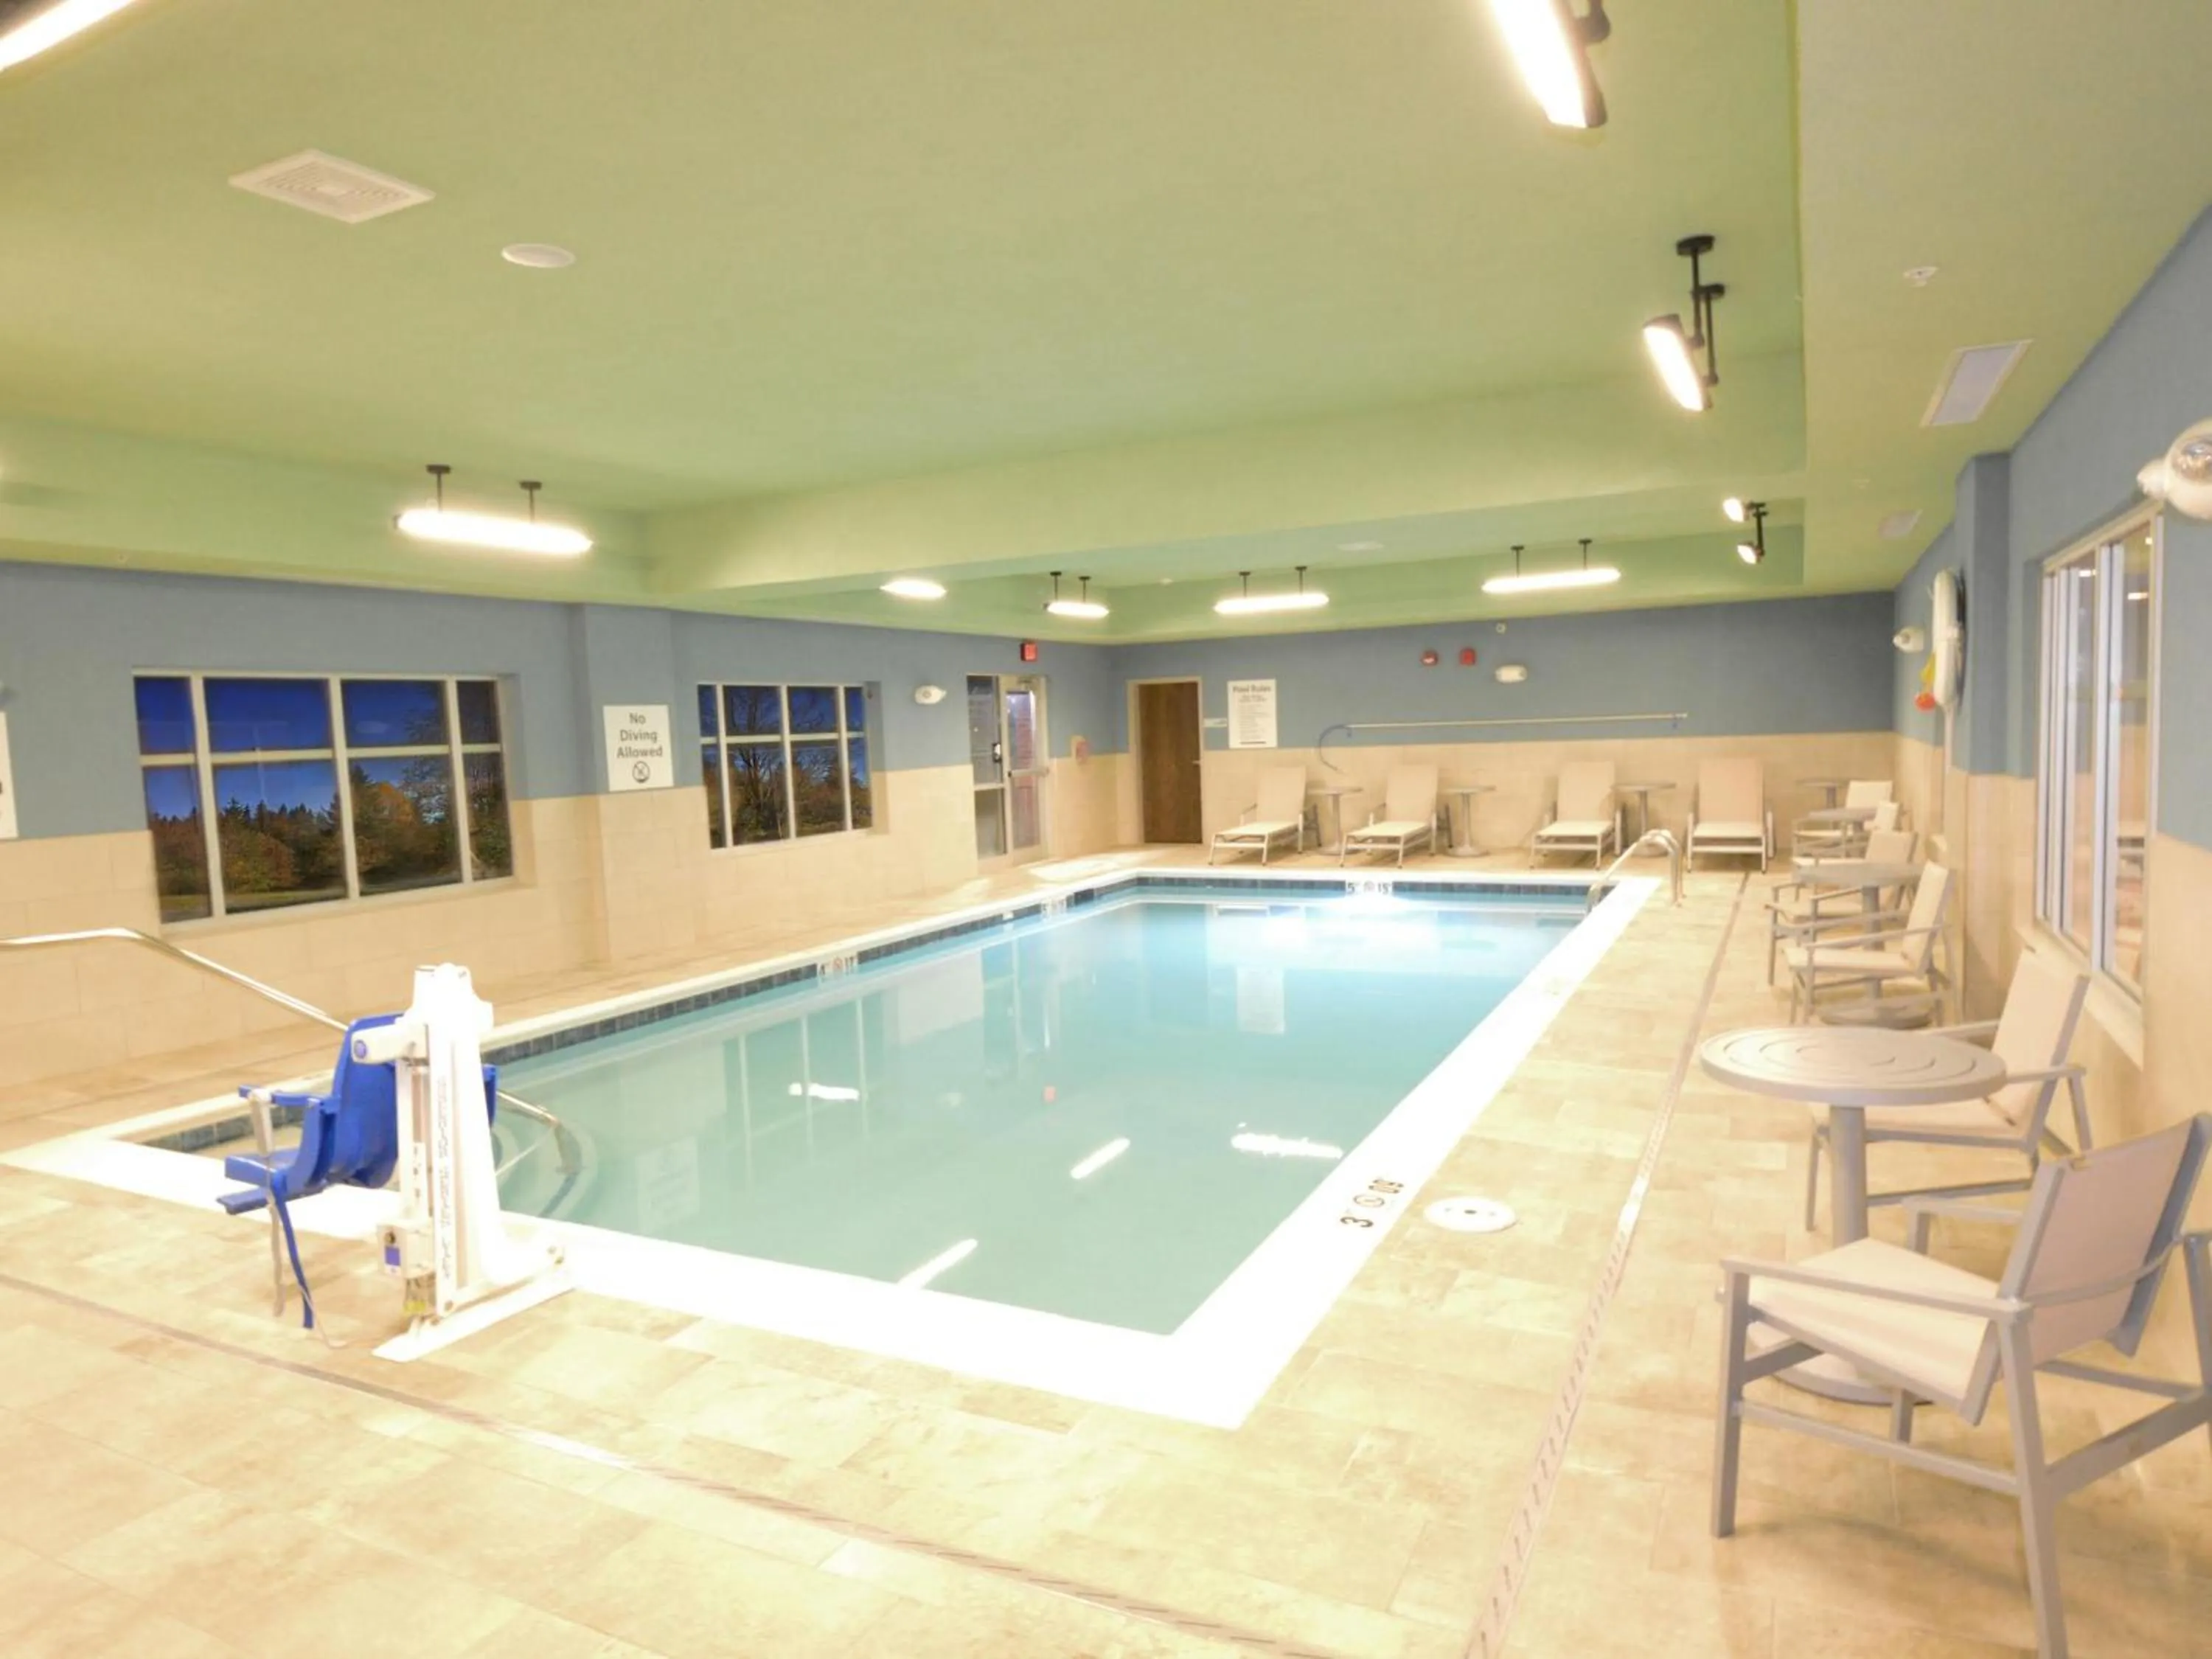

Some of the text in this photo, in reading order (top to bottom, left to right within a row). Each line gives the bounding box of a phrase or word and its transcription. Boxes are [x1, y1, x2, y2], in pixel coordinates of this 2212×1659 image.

[629, 712, 646, 724] No
[619, 729, 658, 742] Diving
[616, 745, 663, 759] Allowed
